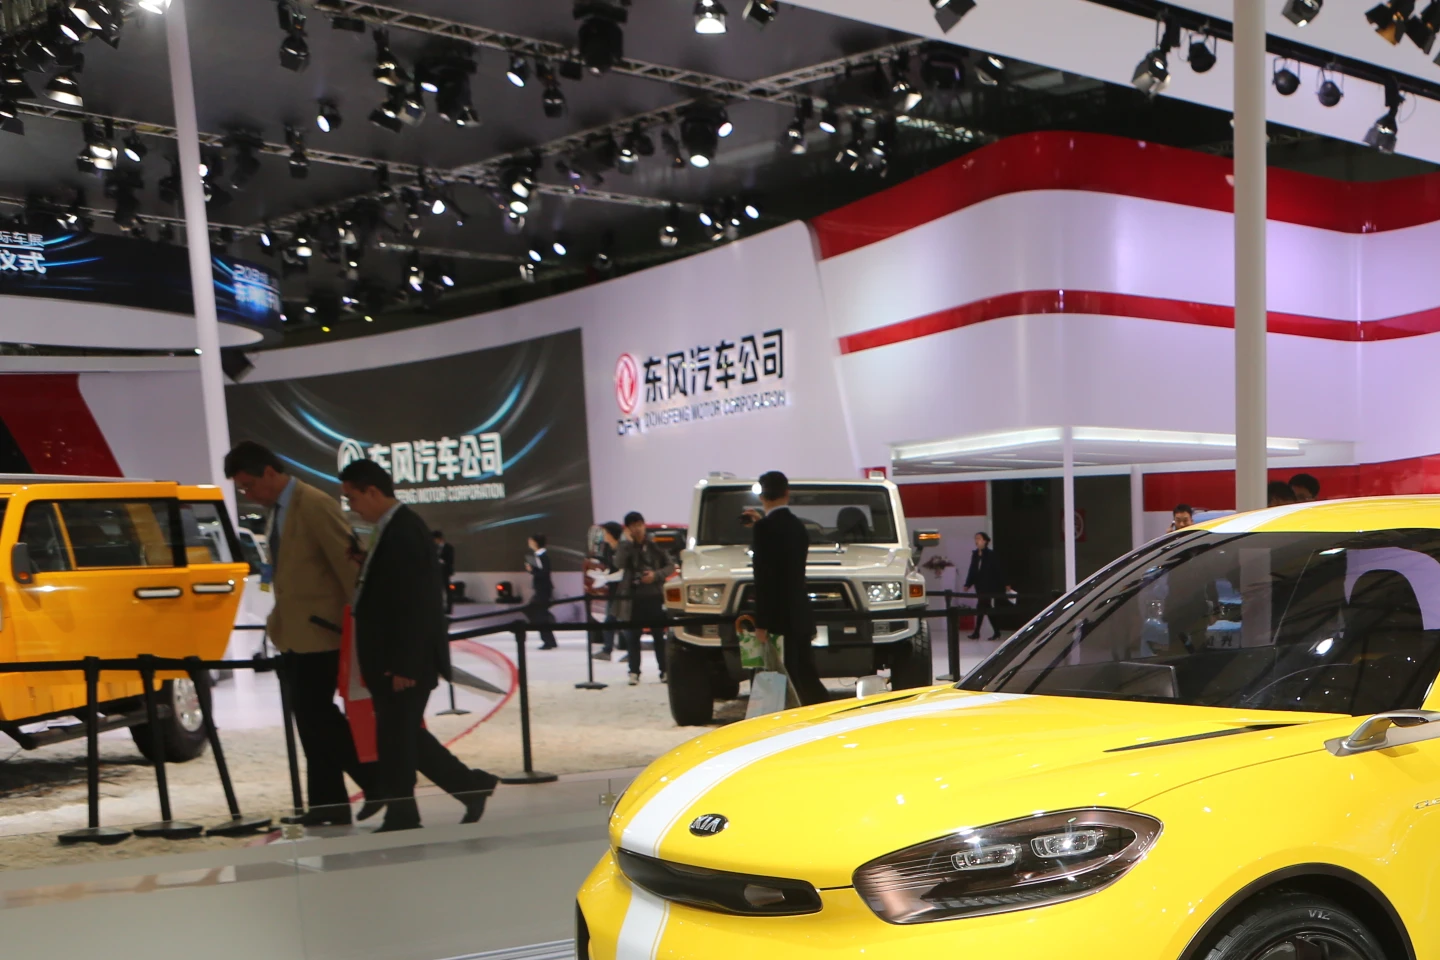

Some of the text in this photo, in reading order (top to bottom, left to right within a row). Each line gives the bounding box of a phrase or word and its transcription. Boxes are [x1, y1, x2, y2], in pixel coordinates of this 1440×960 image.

[643, 328, 784, 402] 东风汽车公司
